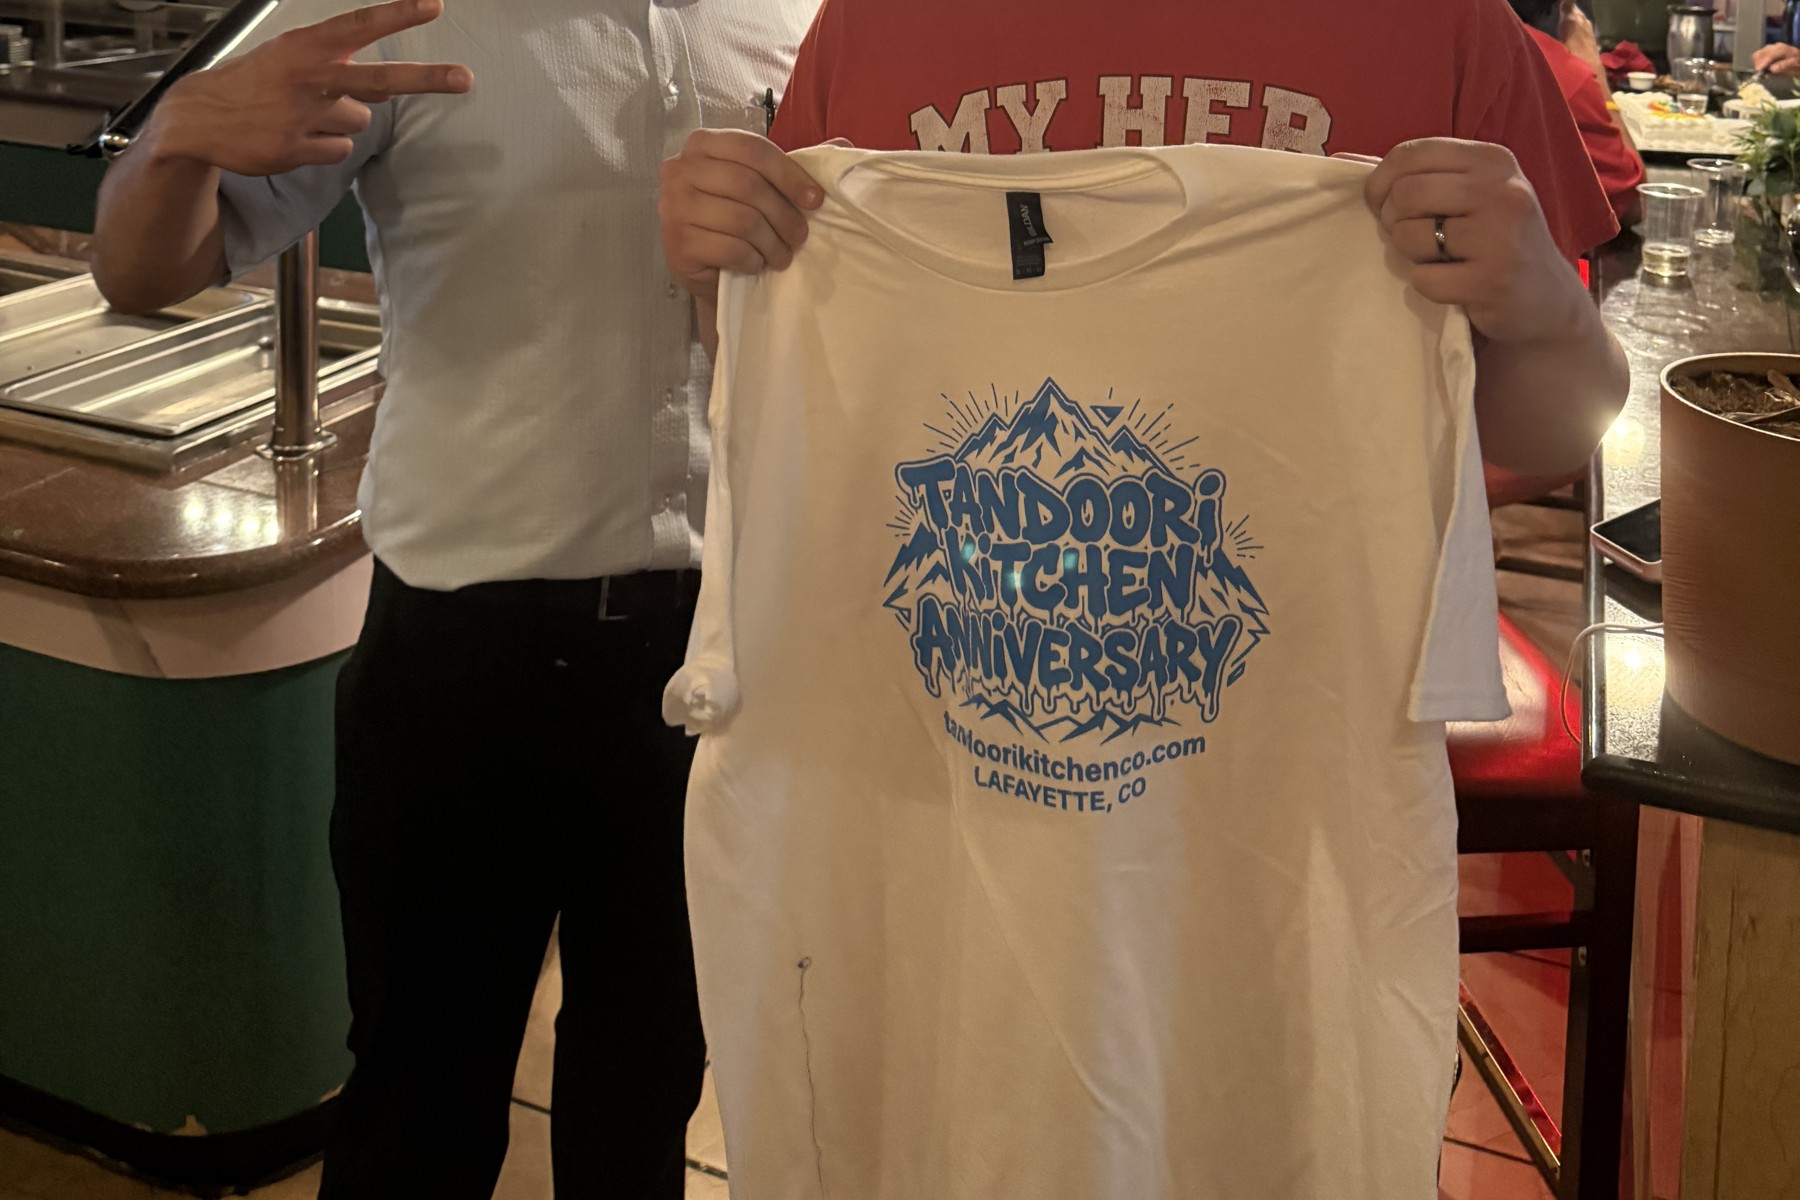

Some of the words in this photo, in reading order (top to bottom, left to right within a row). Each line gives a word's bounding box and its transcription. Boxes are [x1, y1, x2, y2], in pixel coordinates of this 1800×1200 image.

[910, 79, 1067, 155] MY
[974, 766, 1112, 812] LAFAYETTE,
[1118, 777, 1147, 804] CO
